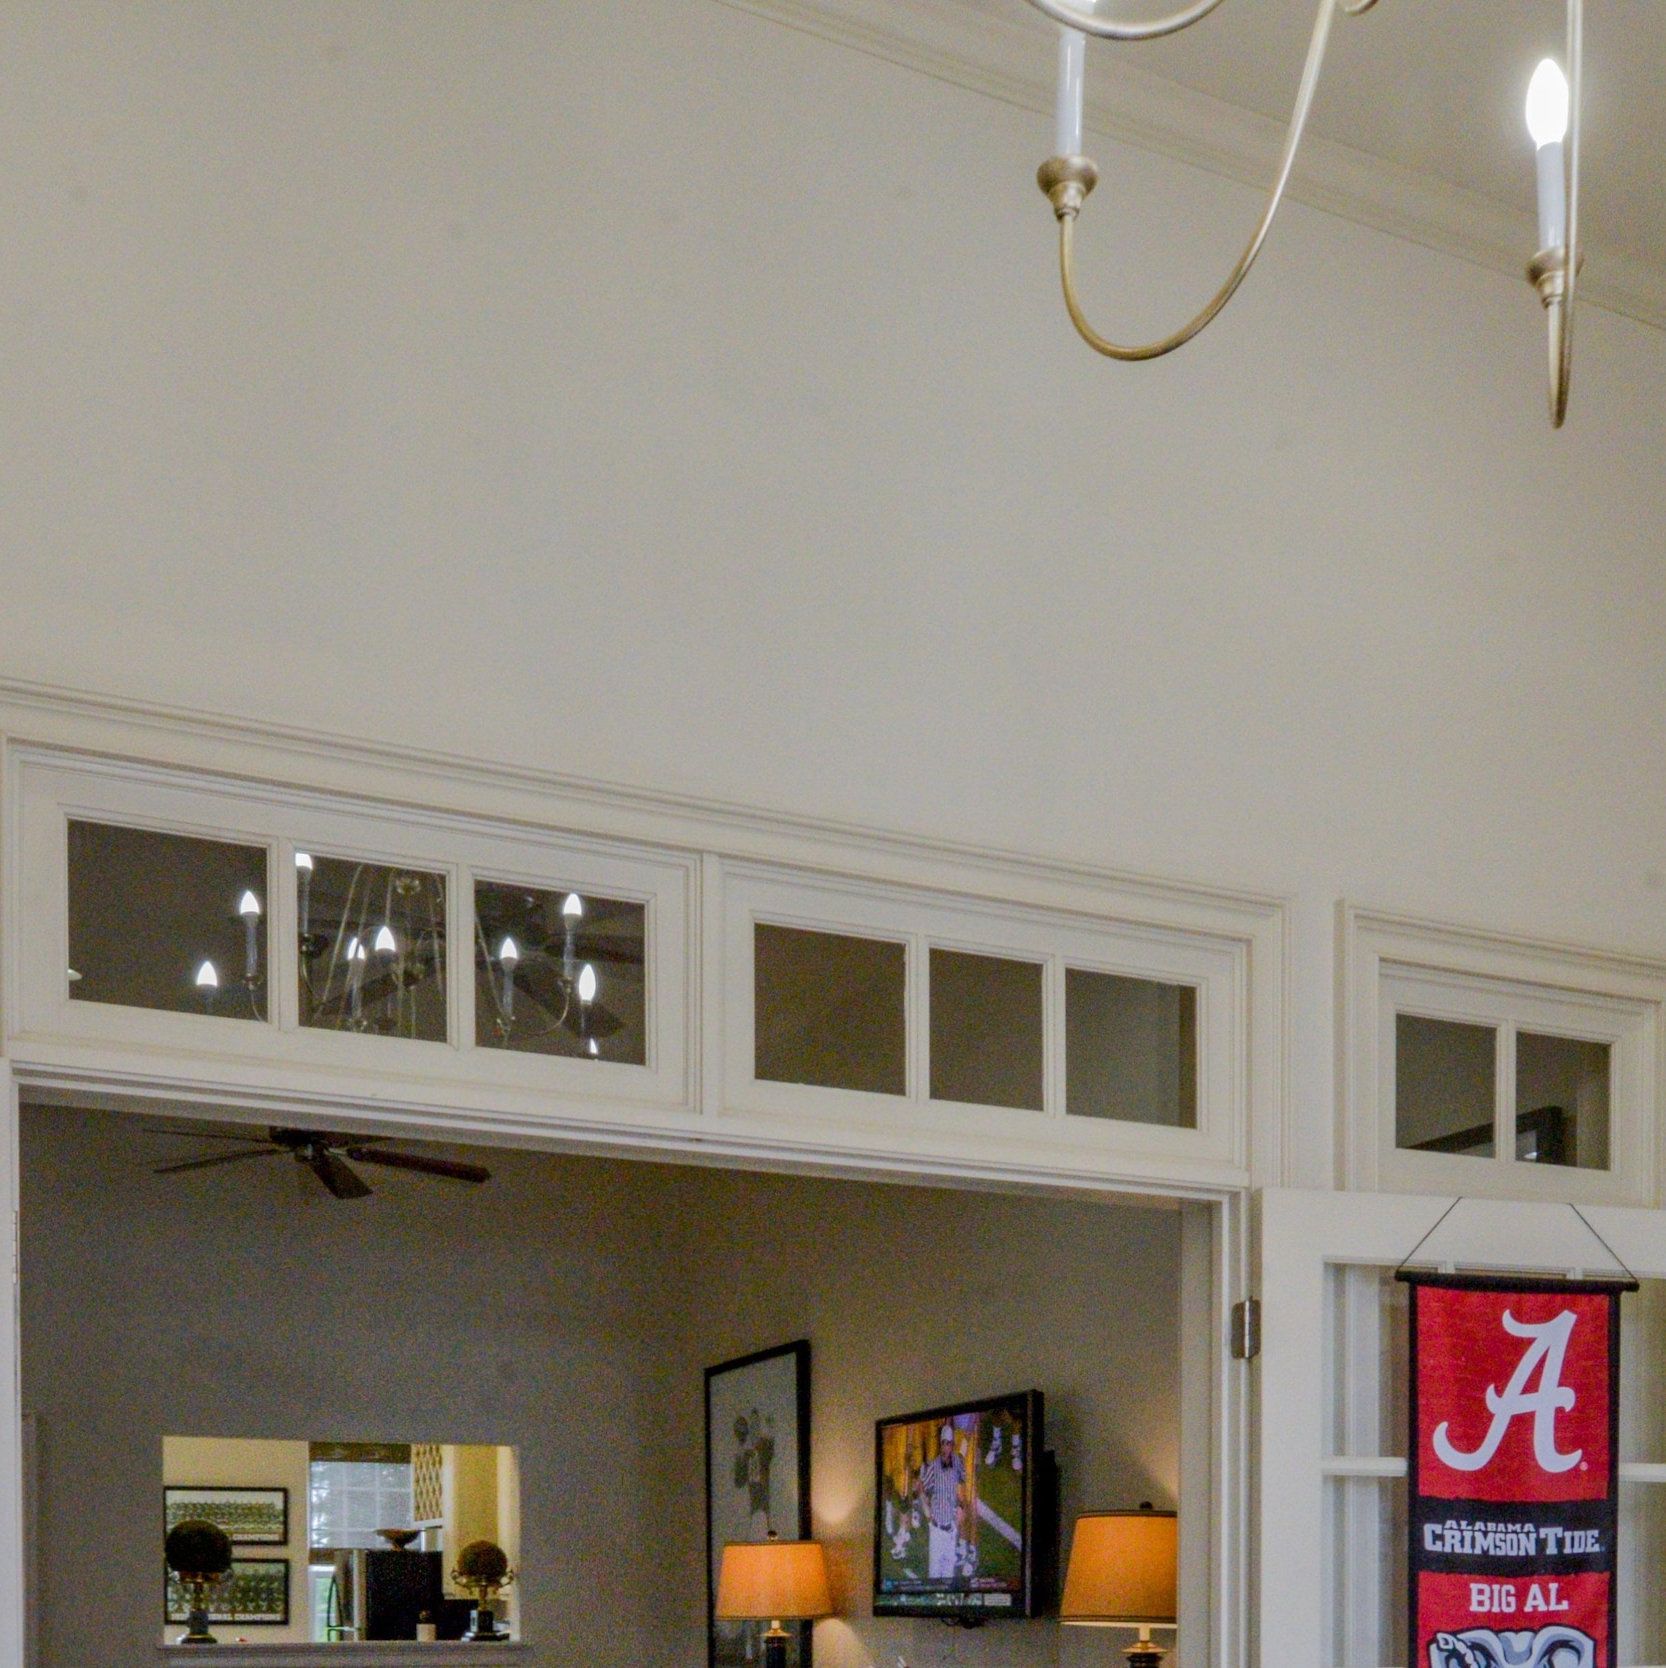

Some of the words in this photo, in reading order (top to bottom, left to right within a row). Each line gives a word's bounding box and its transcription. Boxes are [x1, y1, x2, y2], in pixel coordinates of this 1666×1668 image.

[1433, 1309, 1582, 1473] A
[1423, 1523, 1537, 1556] CRIMSON
[1539, 1527, 1600, 1555] TIDE
[1444, 1520, 1535, 1532] ALABAMA
[1469, 1583, 1516, 1613] BIG
[1524, 1582, 1569, 1612] AL
